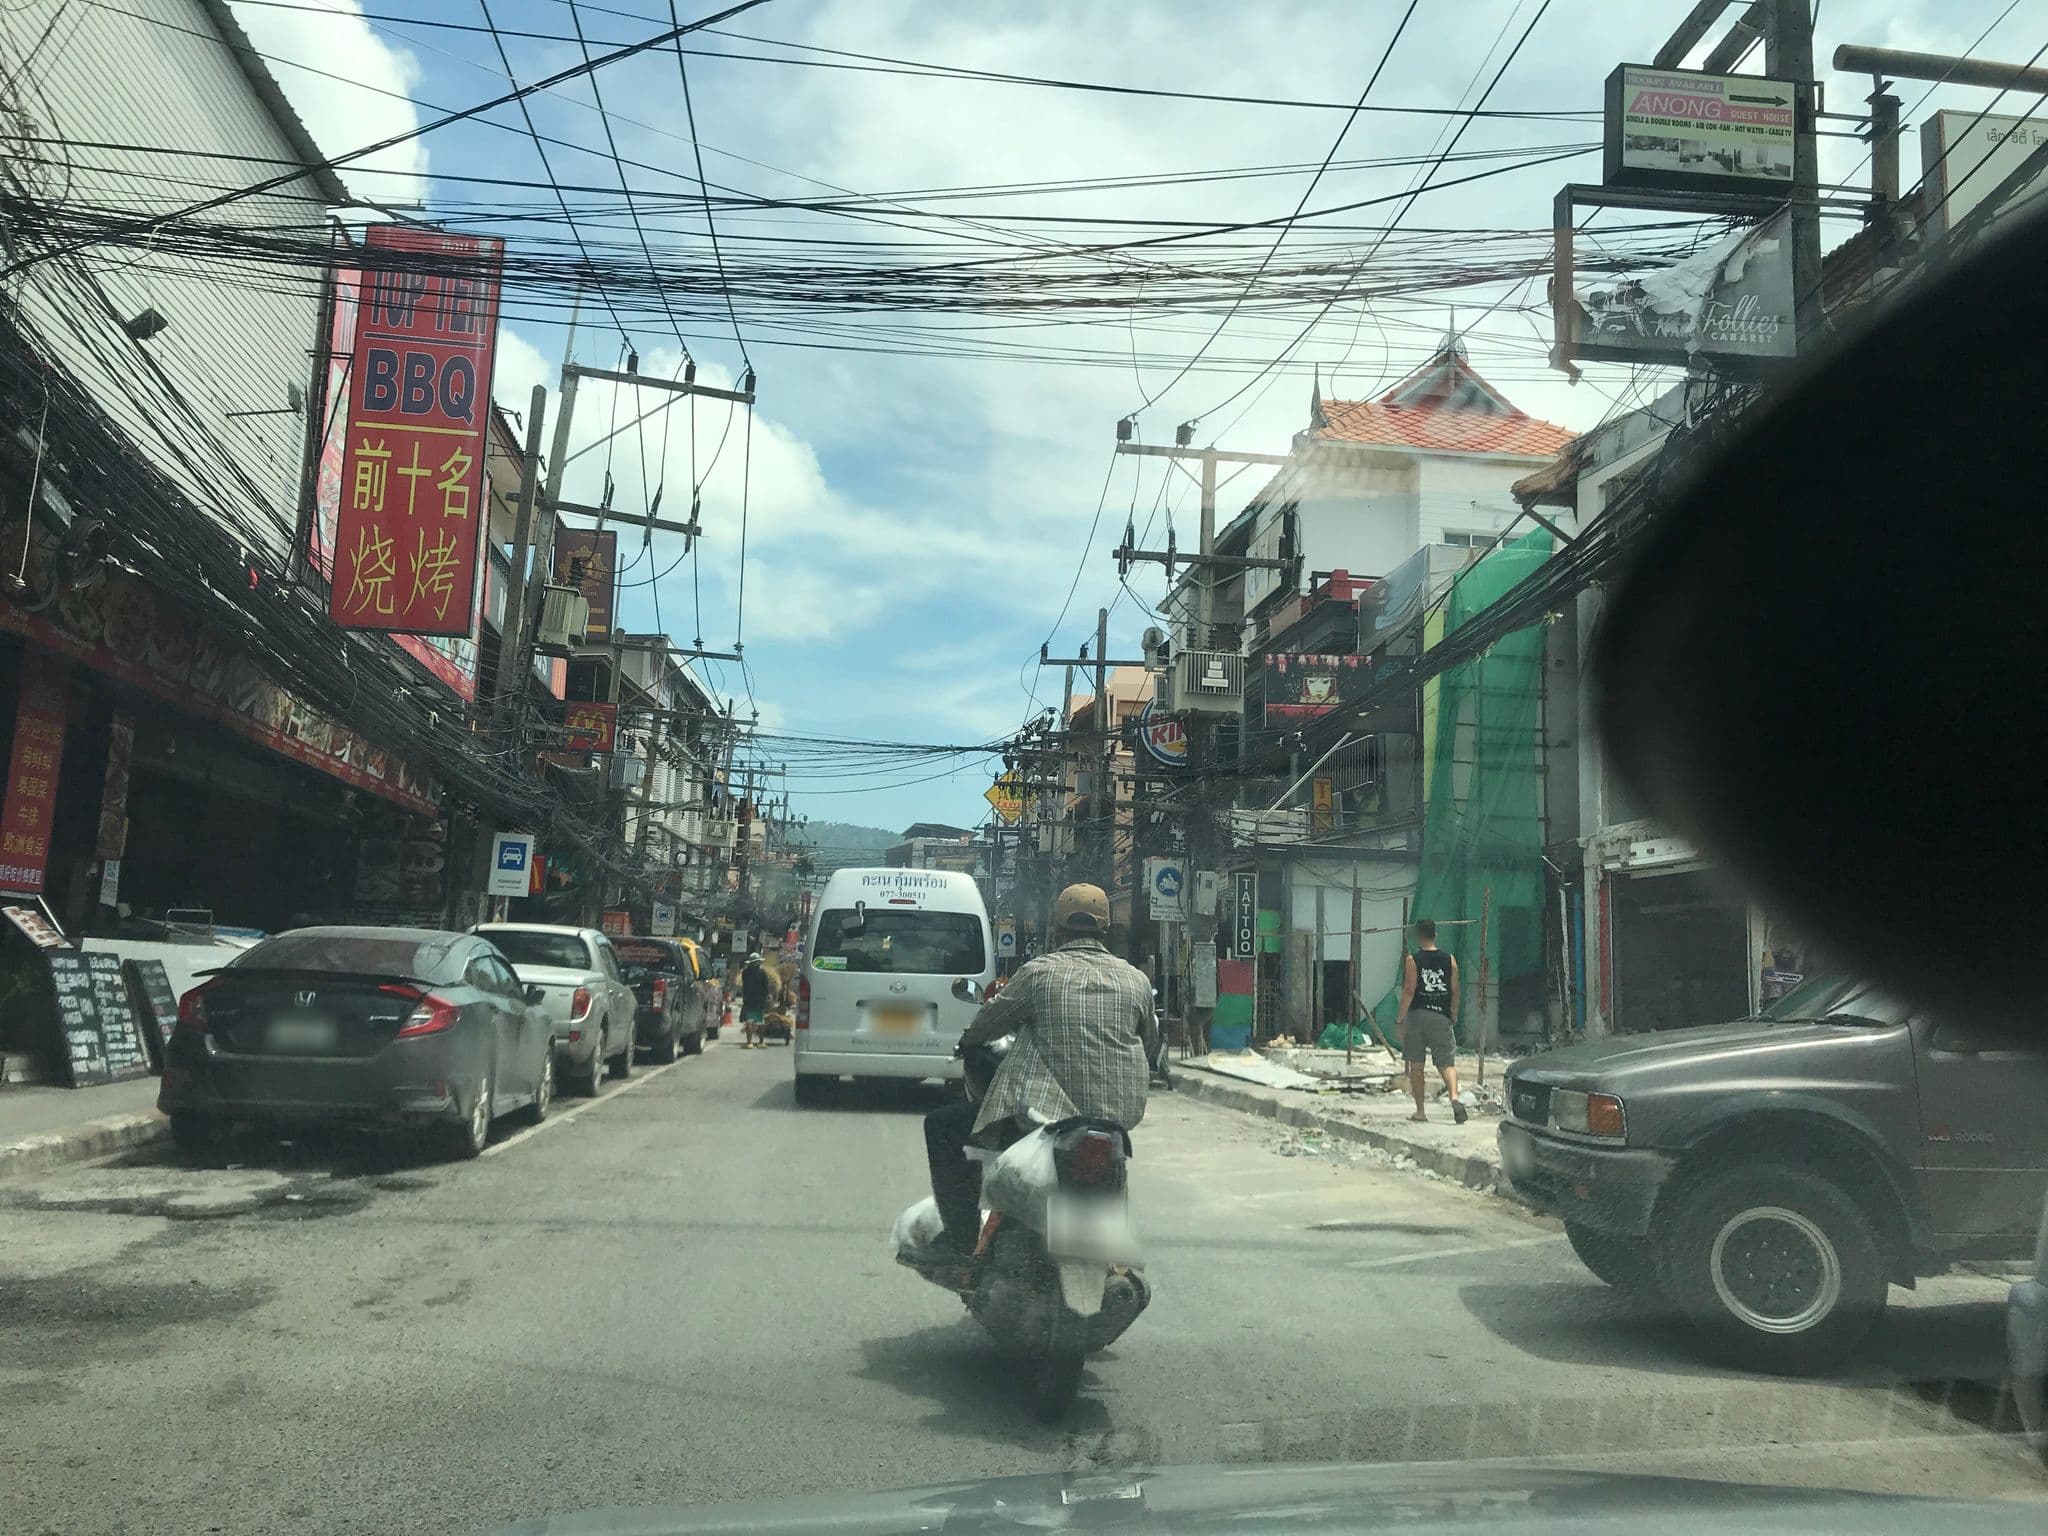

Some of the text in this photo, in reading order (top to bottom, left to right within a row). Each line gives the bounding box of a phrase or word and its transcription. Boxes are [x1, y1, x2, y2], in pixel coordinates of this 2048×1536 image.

[1635, 95, 1721, 118] ANONG
[1650, 117, 1671, 126] DOUBLE
[1672, 119, 1691, 128] ROOMS
[1695, 121, 1705, 129] AIR
[1734, 125, 1746, 133] HOT
[1746, 126, 1764, 134] WATER
[1769, 128, 1784, 136] CABLE
[1785, 129, 1792, 137] TV
[1730, 110, 1791, 123] GUEST HOUSE
[369, 268, 491, 337] TOP TEN
[1703, 295, 1779, 334] Follies
[1711, 332, 1773, 344] CABARET
[362, 348, 476, 425] BBQ
[352, 437, 473, 520] 前十名
[341, 523, 461, 622] 烧烤
[1240, 879, 1251, 952] TATTOO
